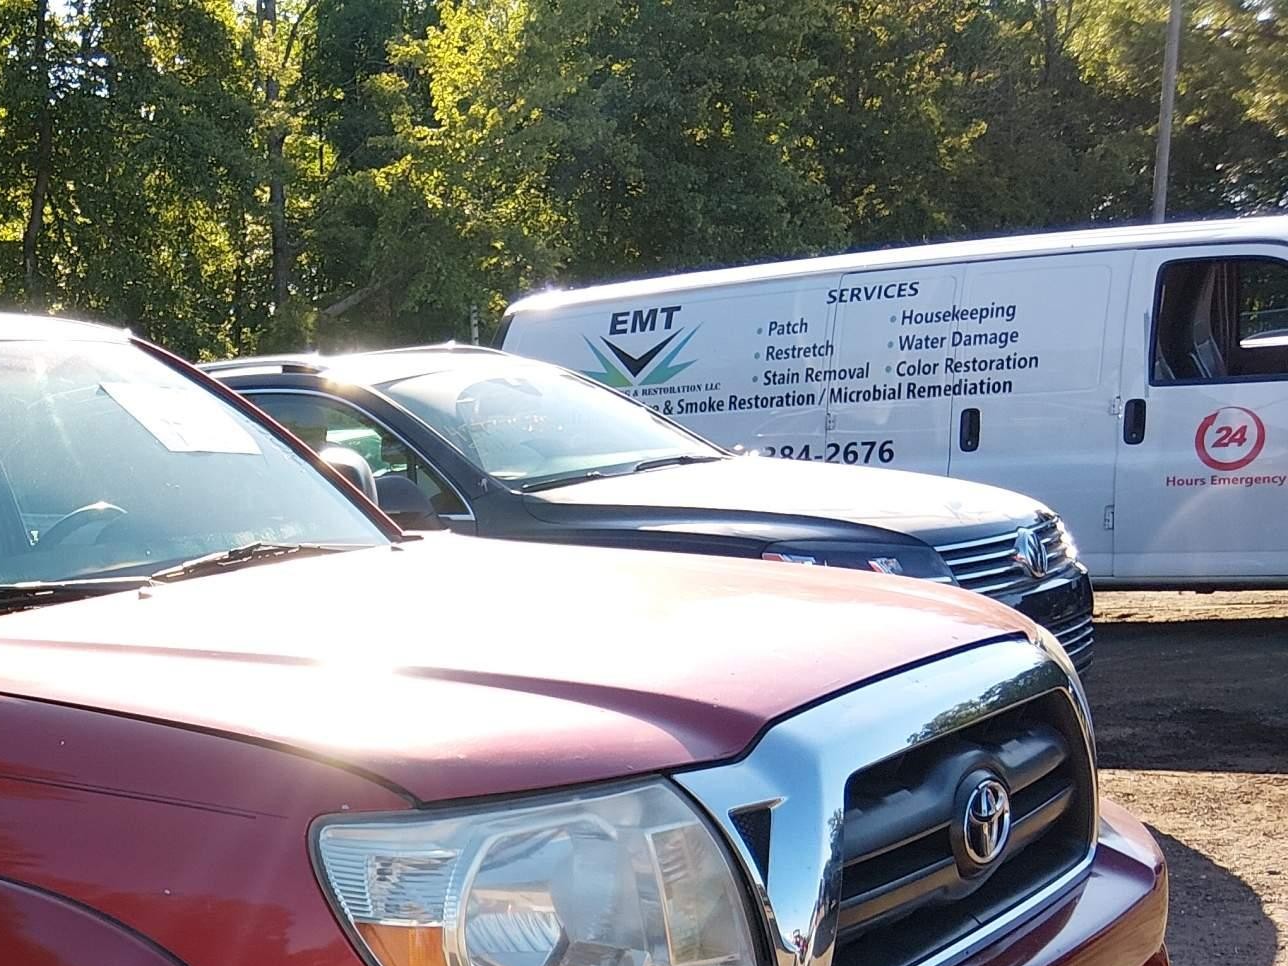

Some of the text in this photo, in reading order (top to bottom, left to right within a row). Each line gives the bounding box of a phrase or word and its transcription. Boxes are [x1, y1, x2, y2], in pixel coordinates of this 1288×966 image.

[827, 282, 919, 305] SERVICES
[609, 305, 682, 336] EMT
[901, 302, 1016, 326] Housekeeping
[768, 317, 808, 336] Patch
[766, 340, 834, 361] Restretch
[899, 330, 1019, 352] Water Damage
[763, 362, 870, 386] Stain Removal
[896, 352, 1039, 377] Color Restoration
[642, 383, 703, 396] RESTORATION
[705, 382, 721, 392] LLC
[663, 400, 674, 416] &
[677, 396, 725, 415] Smoke
[728, 390, 815, 411] Restoration
[829, 382, 902, 404] Microbial
[907, 377, 1013, 399] Remediation
[1211, 425, 1248, 448] 24
[1166, 474, 1287, 488] Hours Emergency
